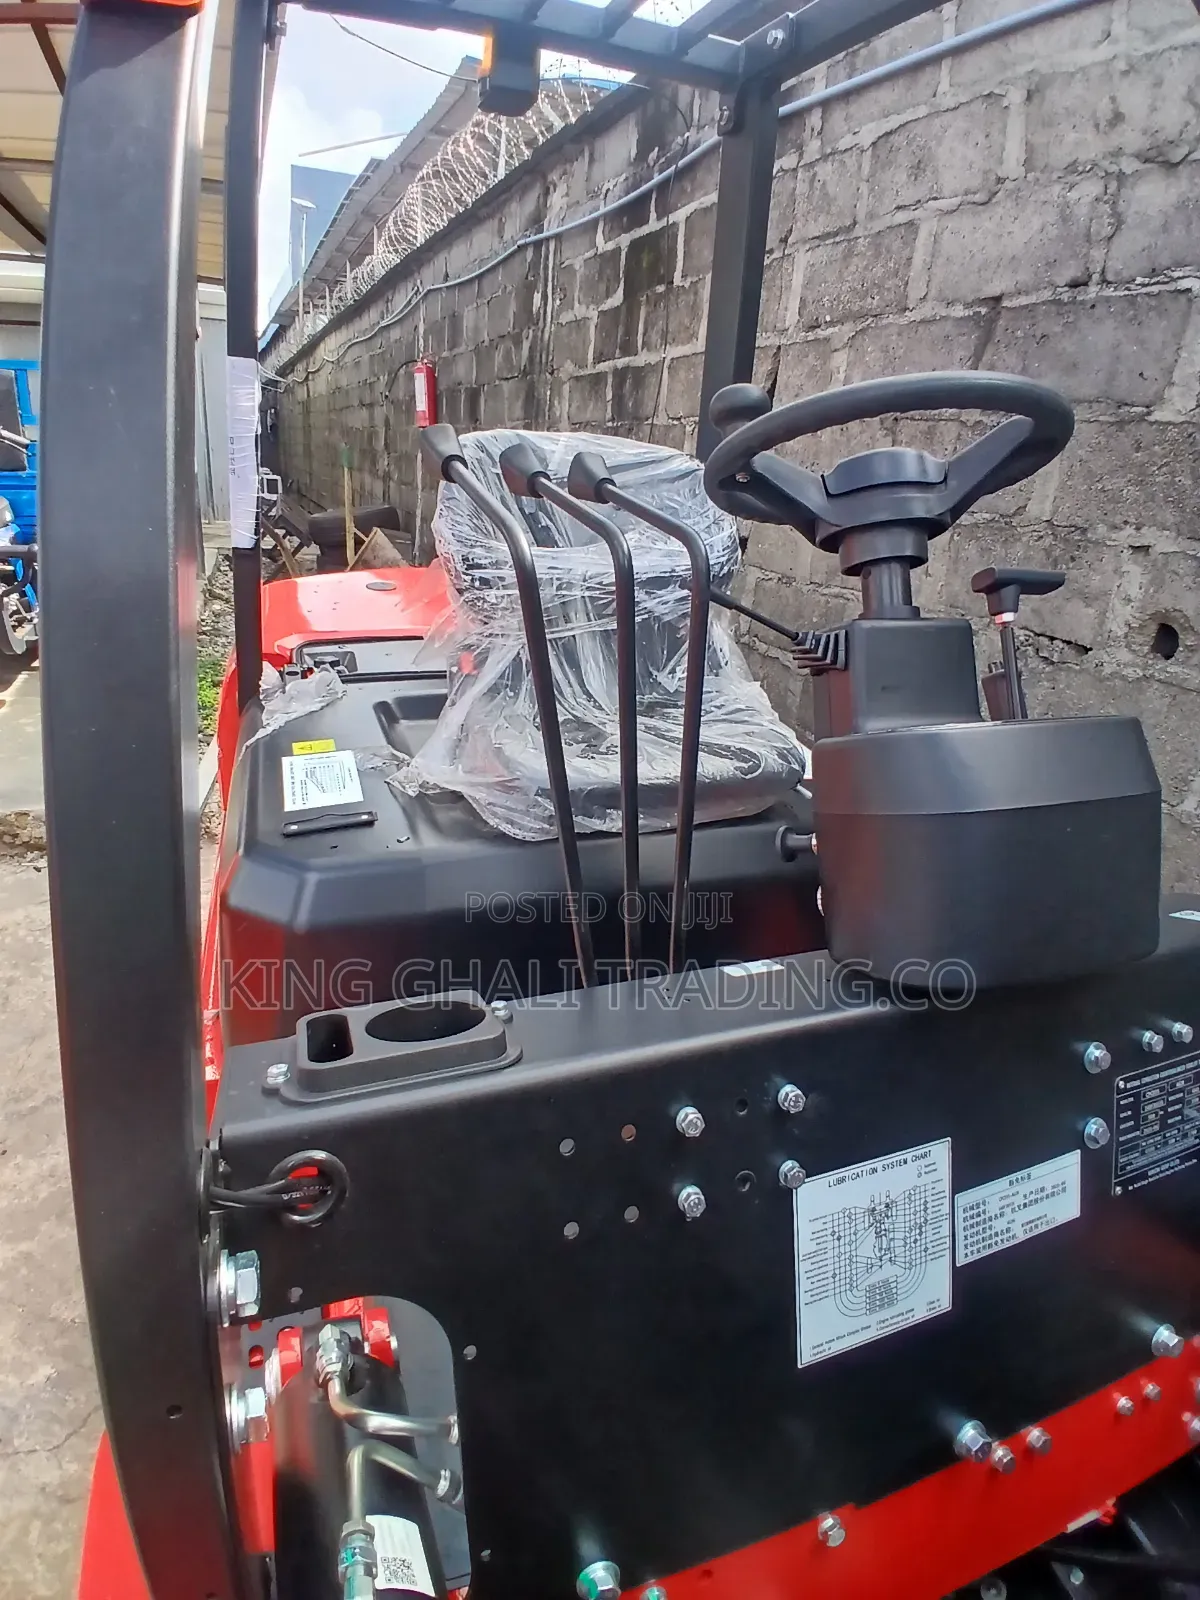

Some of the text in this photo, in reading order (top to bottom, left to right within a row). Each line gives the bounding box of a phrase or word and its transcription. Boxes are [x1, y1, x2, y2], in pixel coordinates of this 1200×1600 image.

[828, 1166, 878, 1188] LUBRICATION
[881, 1157, 908, 1173] SYSTEM
[911, 1149, 932, 1163] CHART
